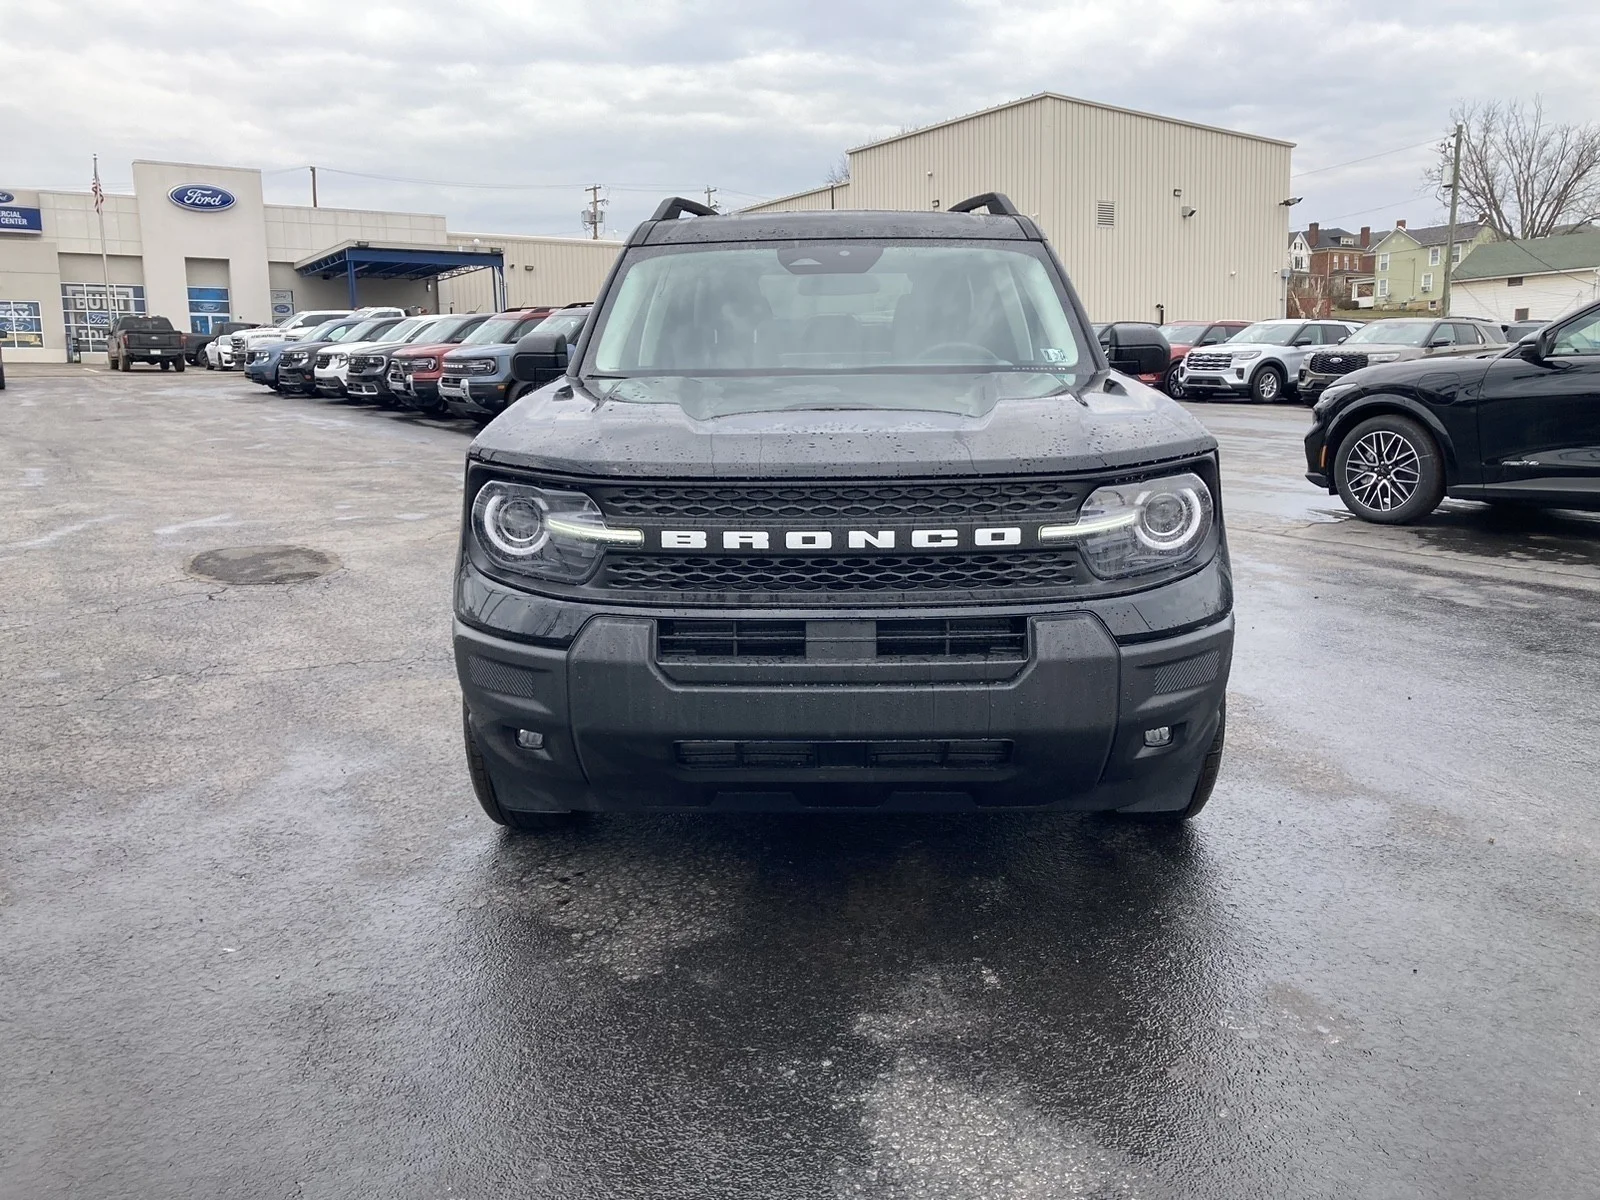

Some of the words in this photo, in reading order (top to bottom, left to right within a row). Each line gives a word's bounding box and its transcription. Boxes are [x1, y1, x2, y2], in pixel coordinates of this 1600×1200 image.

[184, 188, 222, 206] Ford
[0, 210, 21, 218] RCIAL
[1, 217, 28, 226] CENTER
[75, 293, 127, 310] BUILT
[660, 526, 1022, 549] BRONCO
